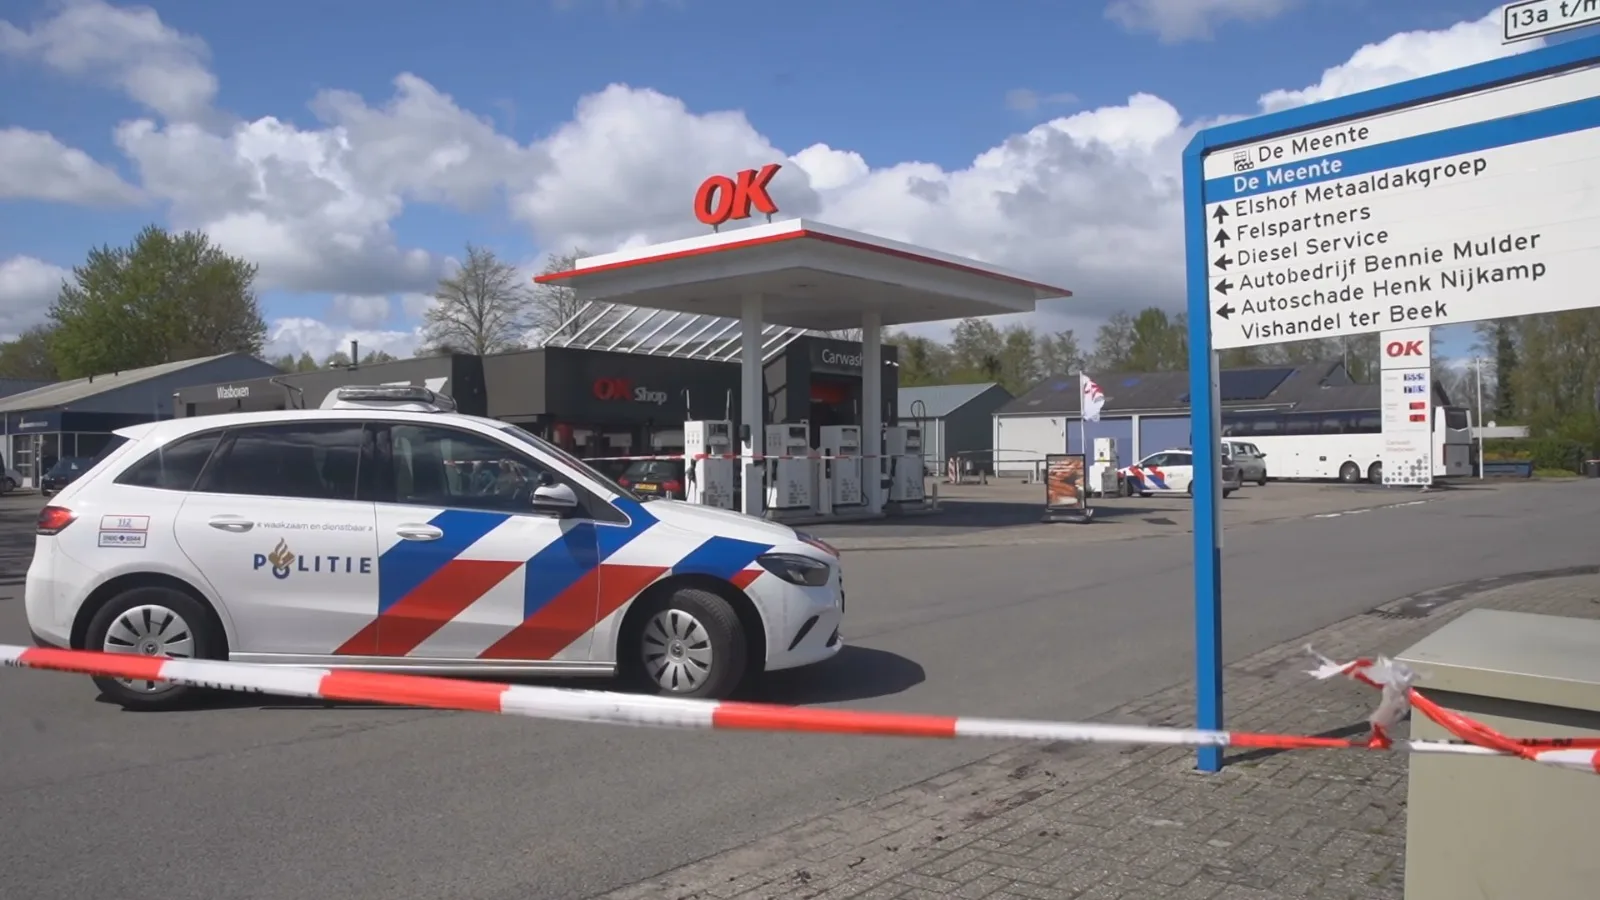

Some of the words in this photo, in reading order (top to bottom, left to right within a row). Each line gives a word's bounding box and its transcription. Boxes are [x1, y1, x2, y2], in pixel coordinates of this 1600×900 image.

[1512, 9, 1548, 28] 13a
[1259, 145, 1284, 163] De
[1292, 126, 1369, 155] Meente
[1234, 175, 1260, 193] De
[1266, 158, 1343, 186] Meente
[1236, 191, 1298, 217] Elshof
[1305, 156, 1487, 205] Metaaldakgroep
[694, 163, 782, 225] OK
[1237, 206, 1371, 241] Felspartners
[1238, 242, 1298, 266] Diesel
[1306, 230, 1389, 255] Service
[1239, 258, 1356, 291] Autobedrijf
[1365, 247, 1443, 273] Bennie
[1453, 234, 1541, 260] Mulder
[1241, 285, 1364, 315] Autoschade
[1373, 275, 1432, 298] Henk
[1441, 262, 1547, 292] Nijkamp
[1241, 313, 1341, 340] Vishandel
[1349, 311, 1381, 327] ter
[1390, 300, 1448, 323] Beek
[1386, 340, 1424, 358] OK
[216, 384, 250, 400] Wasboxen
[593, 378, 632, 400] OK
[634, 386, 668, 405] Shop
[321, 522, 367, 532] dienstbaar
[253, 552, 372, 580] POLITIE
